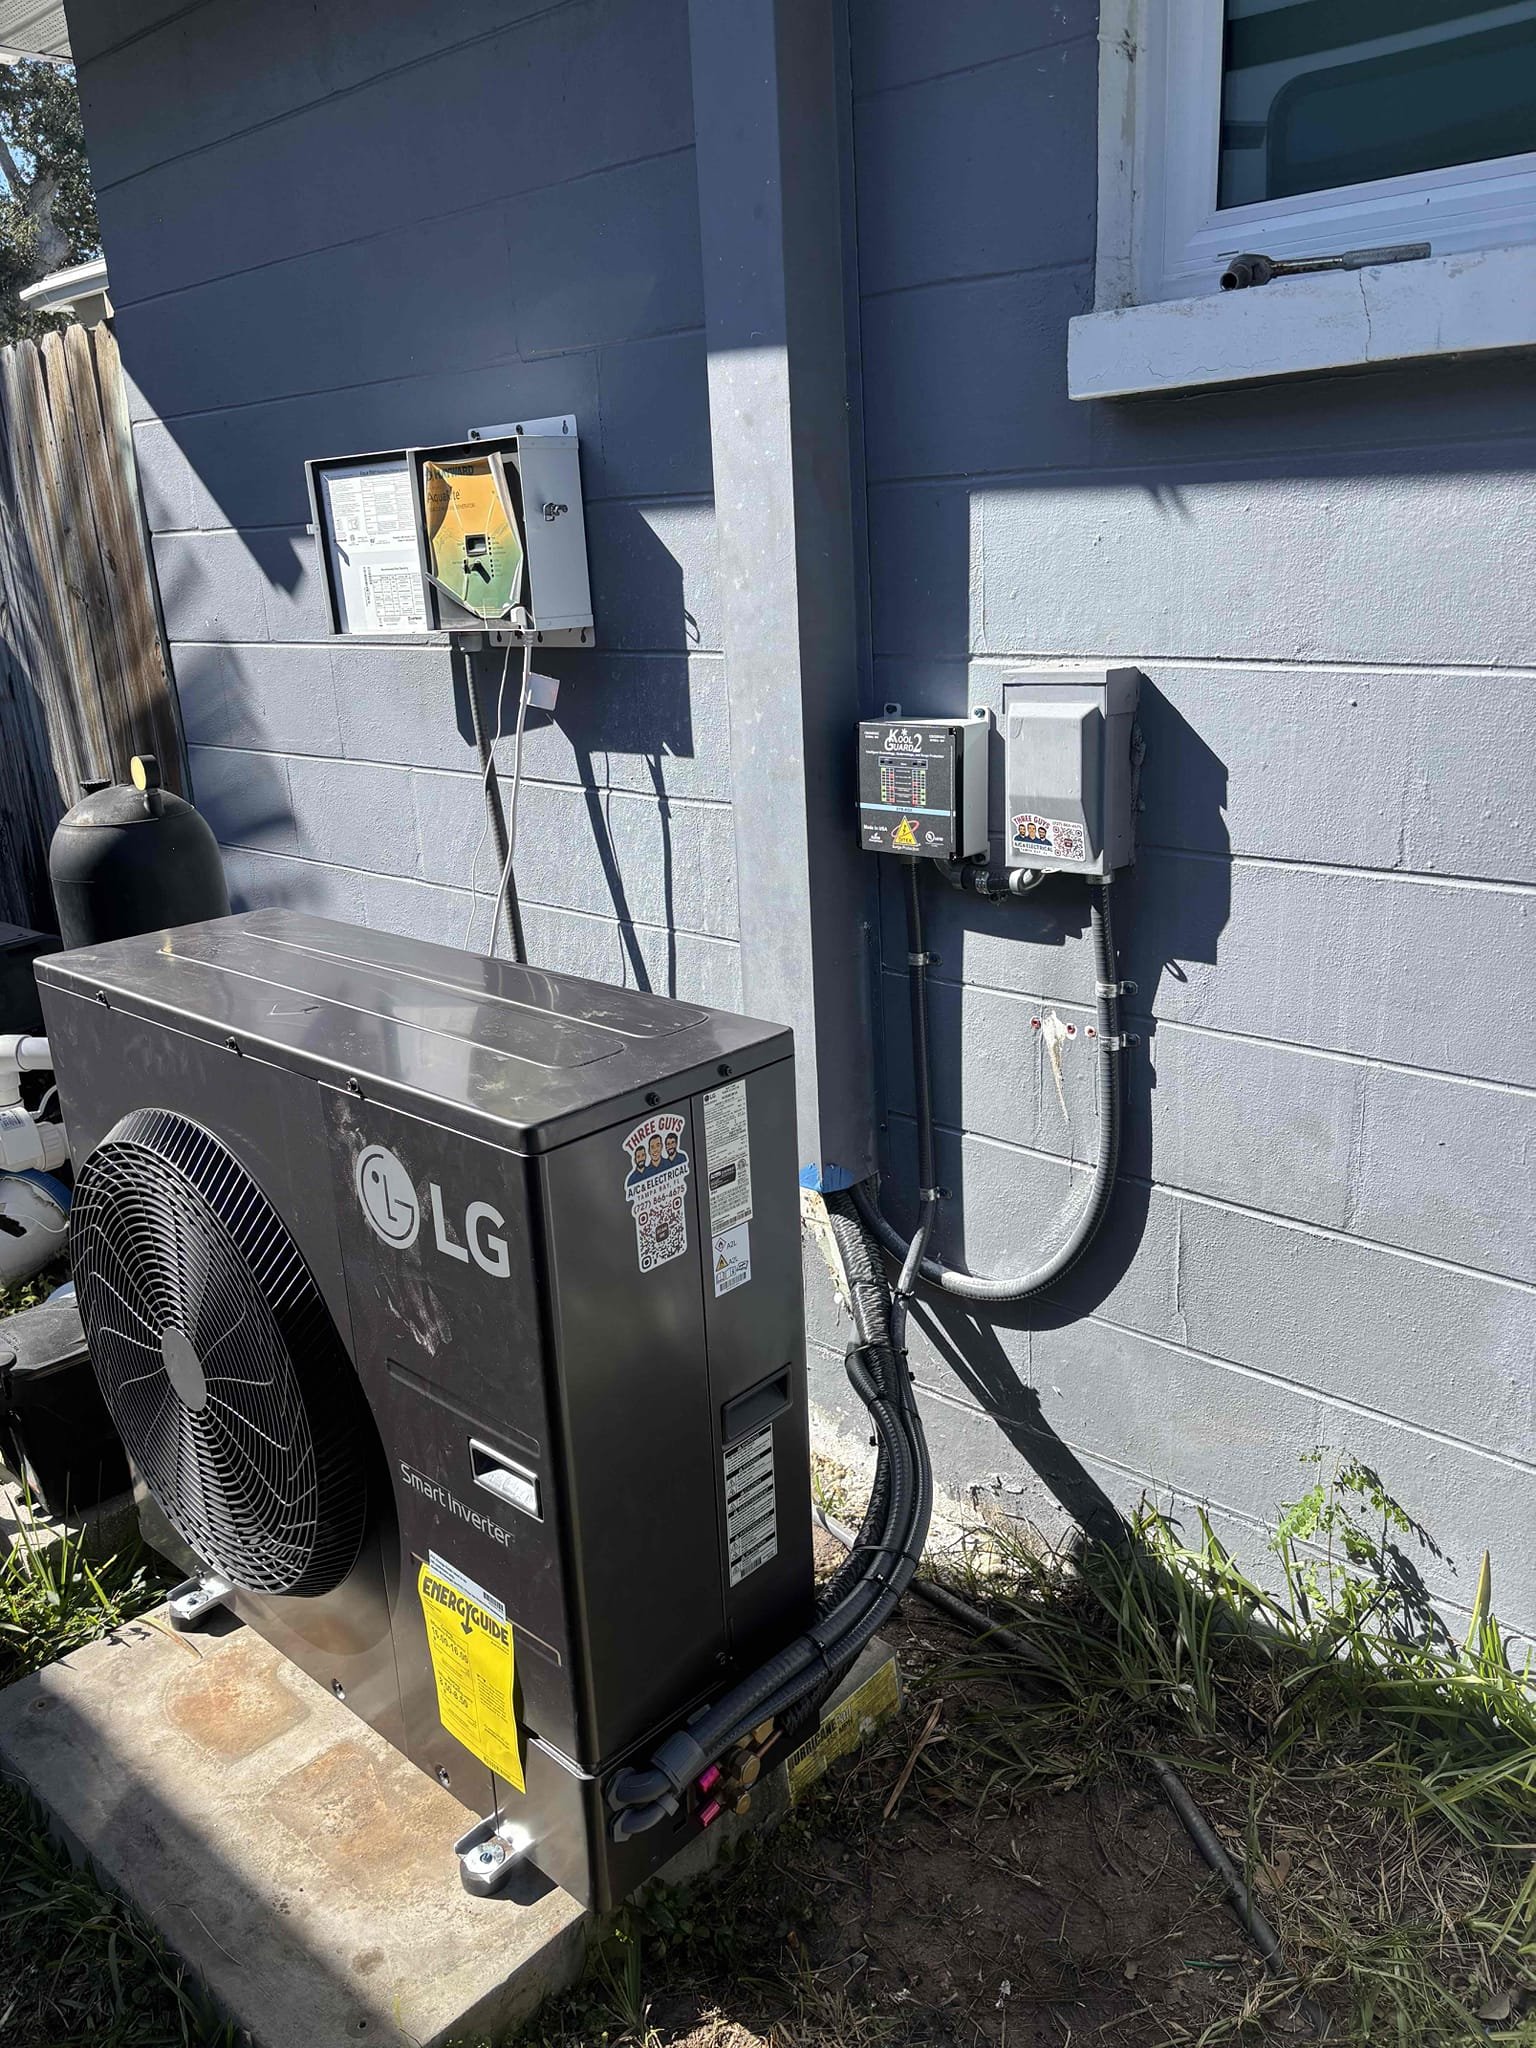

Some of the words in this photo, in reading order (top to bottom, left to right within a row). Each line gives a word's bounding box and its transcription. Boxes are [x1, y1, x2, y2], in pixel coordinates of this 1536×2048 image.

[884, 736, 914, 752] GUARD
[1013, 815, 1032, 825] THREE
[1033, 816, 1050, 829] GUYS
[625, 1121, 656, 1151] THREE
[658, 1116, 684, 1132] GUYS
[634, 1200, 651, 1214] (727)
[430, 1183, 511, 1278] LG
[400, 1463, 446, 1510] Smart
[447, 1491, 513, 1547] Inverter
[423, 1576, 509, 1647] ENERGYGUIDE
